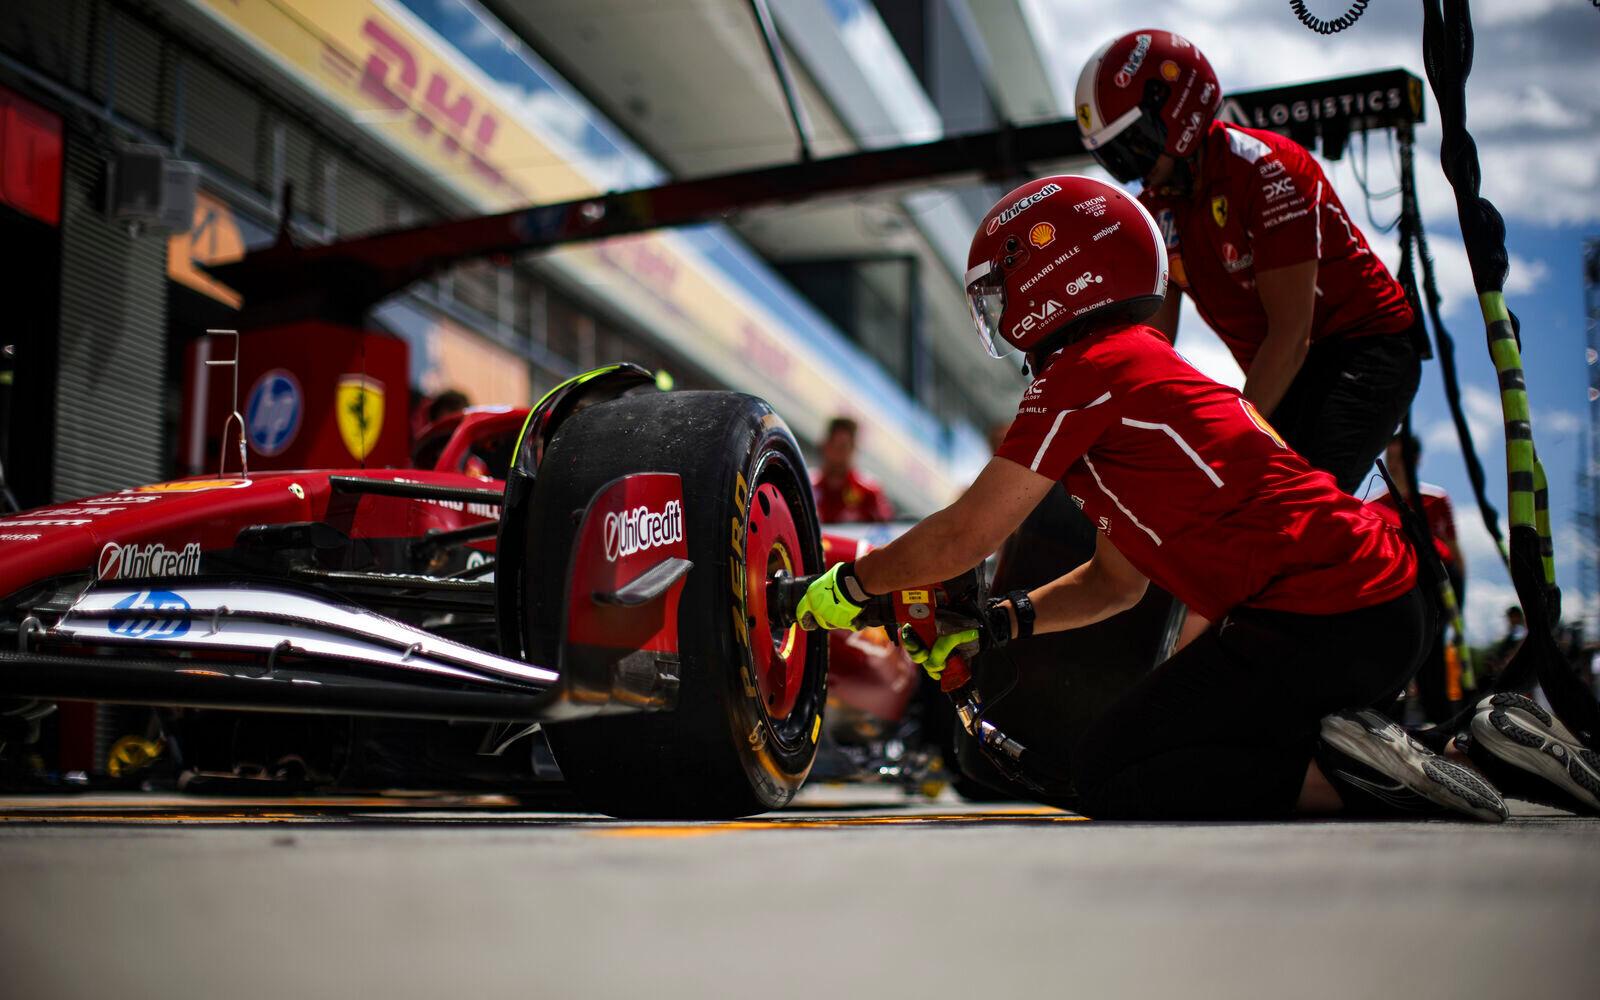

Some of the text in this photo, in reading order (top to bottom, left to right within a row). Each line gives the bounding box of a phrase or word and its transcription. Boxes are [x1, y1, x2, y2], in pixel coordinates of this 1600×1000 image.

[360, 18, 502, 183] DHL
[1253, 87, 1401, 127] LOGISTICS
[999, 182, 1062, 226] UniCredit
[1073, 195, 1107, 213] PERONI
[1019, 245, 1081, 293] RICHARD MILLE
[1037, 307, 1067, 330] LOGISTICS
[1073, 301, 1106, 317] VIGLIONE
[618, 499, 683, 557] UniCredit
[120, 542, 201, 580] UniCredit
